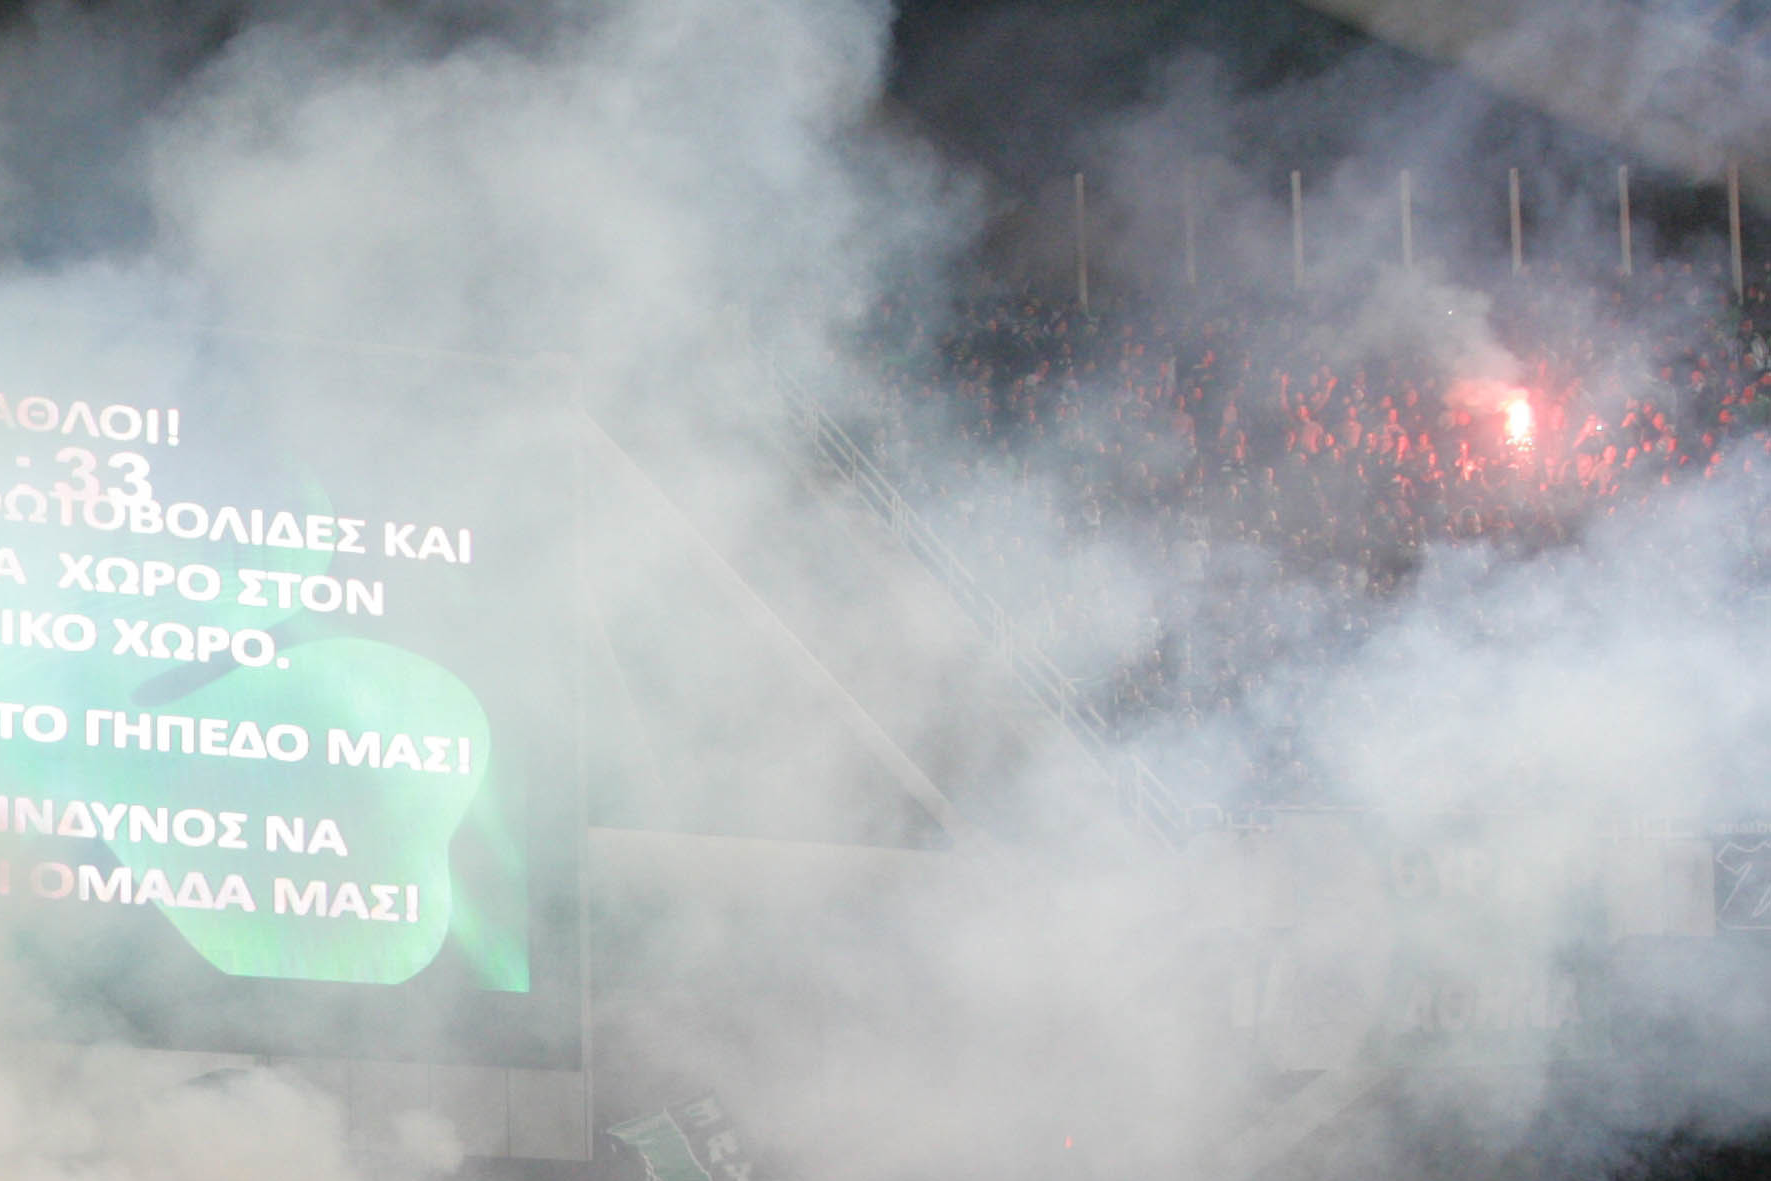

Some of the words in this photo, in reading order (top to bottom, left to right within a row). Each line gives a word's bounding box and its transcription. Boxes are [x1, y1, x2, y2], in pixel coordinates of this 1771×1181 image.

[384, 521, 472, 564] ΚΑΙ
[58, 552, 221, 601] ΧΩΡΟ
[237, 568, 384, 616] ΣΤΟΝ
[112, 618, 290, 670] ΧΩΡΟ.
[85, 708, 310, 762] ΓΗΠΕΔΟ
[327, 728, 472, 775] ΜΑΣ!
[265, 815, 348, 857] ΝΑ
[30, 860, 257, 913] ΟΜΑΔΑ
[273, 877, 420, 923] ΜΑΣ!
